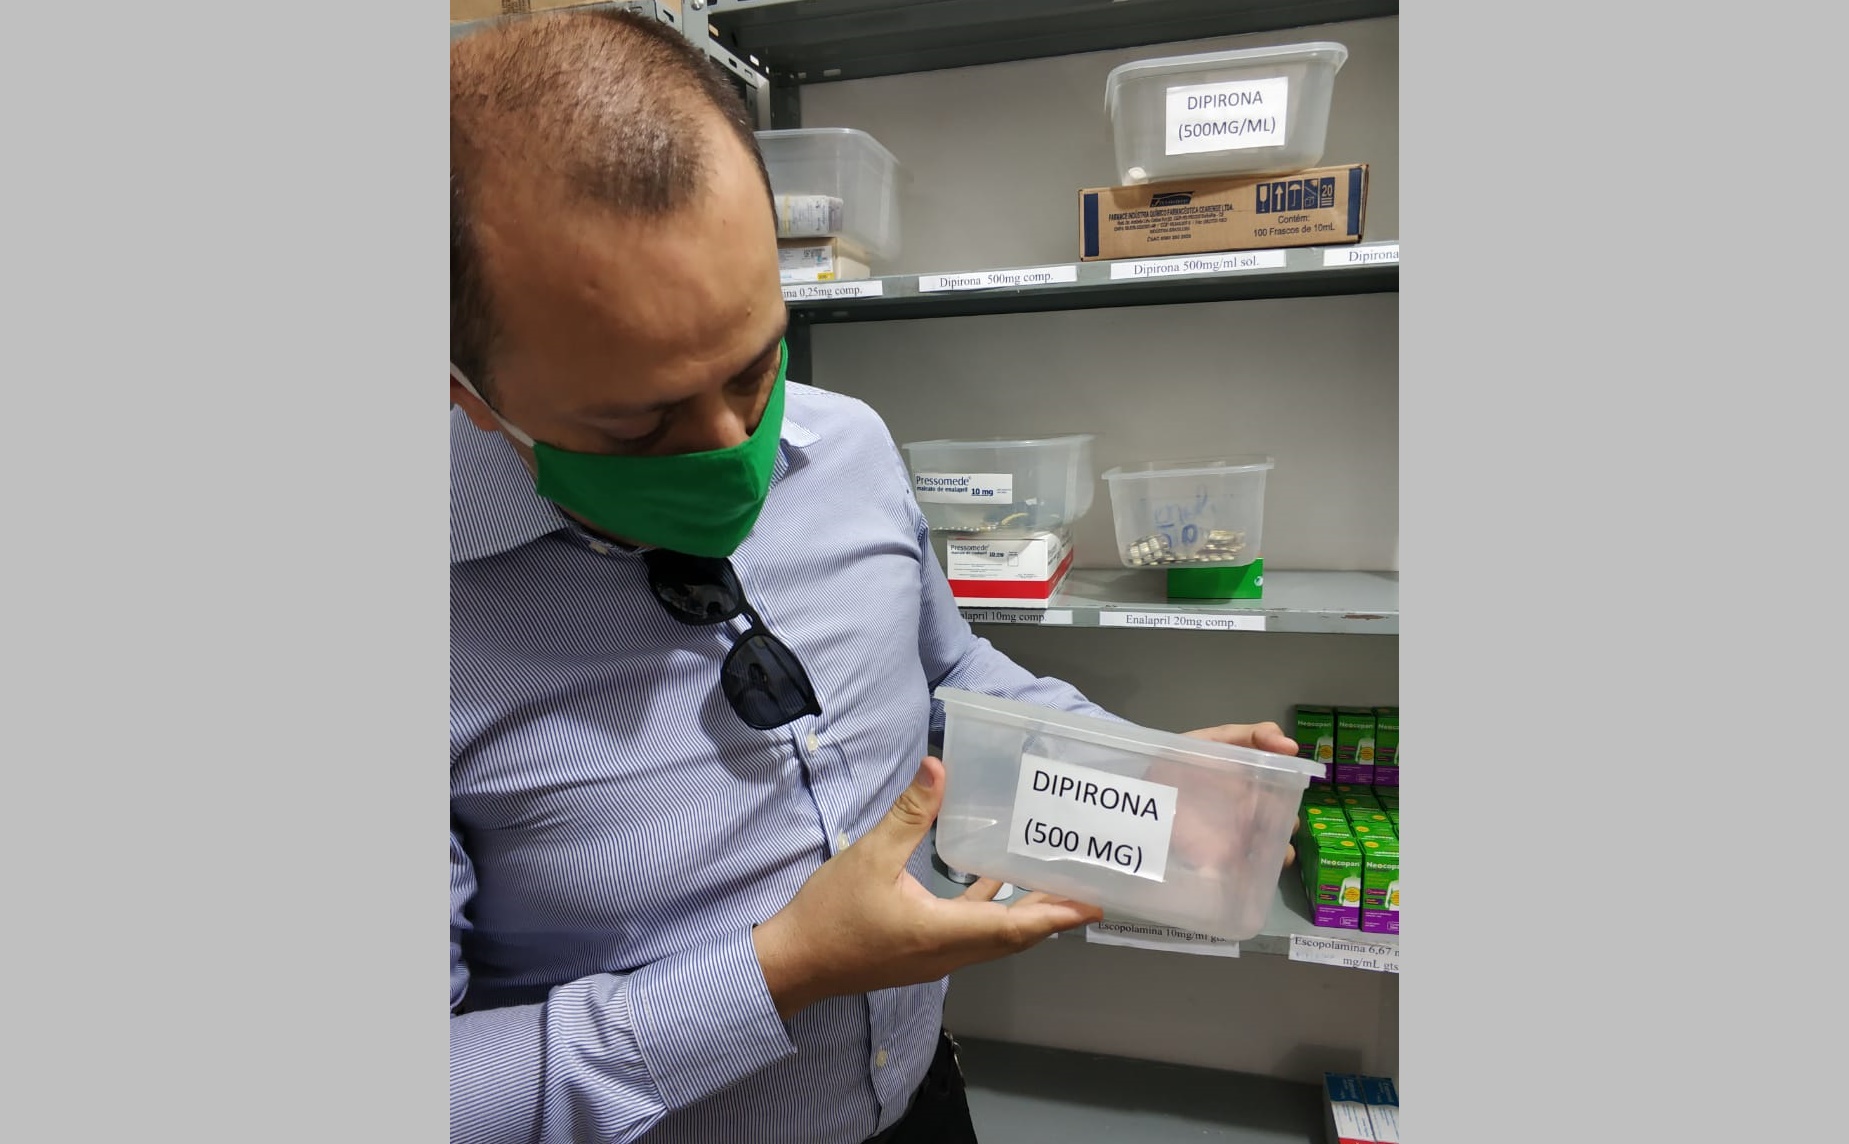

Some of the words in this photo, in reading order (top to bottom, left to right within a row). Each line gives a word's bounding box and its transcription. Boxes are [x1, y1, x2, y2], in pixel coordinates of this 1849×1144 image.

[1187, 91, 1263, 110] DIPIRONA
[1179, 117, 1276, 141] (500MG/ML)
[1322, 184, 1333, 197] 20
[1278, 215, 1310, 224] Contém:
[1254, 228, 1267, 237] 100
[1269, 226, 1299, 236] Frascos
[1302, 225, 1312, 233] de
[1349, 250, 1399, 263] Dipirona
[1134, 263, 1179, 277] Dipirona
[1183, 257, 1237, 272] 500mg/ml
[1240, 255, 1259, 267] sol.
[940, 277, 981, 289] Dipirona
[987, 273, 1020, 285] 500mg
[1024, 272, 1054, 284] comp.
[800, 286, 832, 298] 0,25mg
[835, 286, 863, 298] comp.
[916, 475, 969, 486] Pressomede
[961, 611, 988, 622] lapril
[991, 611, 1016, 622] 10mg
[1019, 613, 1047, 623] comp.
[1126, 614, 1170, 627] Enalapril
[1174, 616, 1202, 628] 20mg
[1206, 619, 1237, 629] comp.
[1033, 769, 1159, 821] DIPIRONA
[1024, 818, 1079, 852] (500
[1087, 836, 1142, 873] MG)
[1320, 858, 1360, 868] Neocopan
[1098, 922, 1163, 936] Escopolamina
[1294, 936, 1365, 953] Escopolamina
[1368, 944, 1391, 956] 6,67
[1343, 957, 1379, 968] mg/mL
